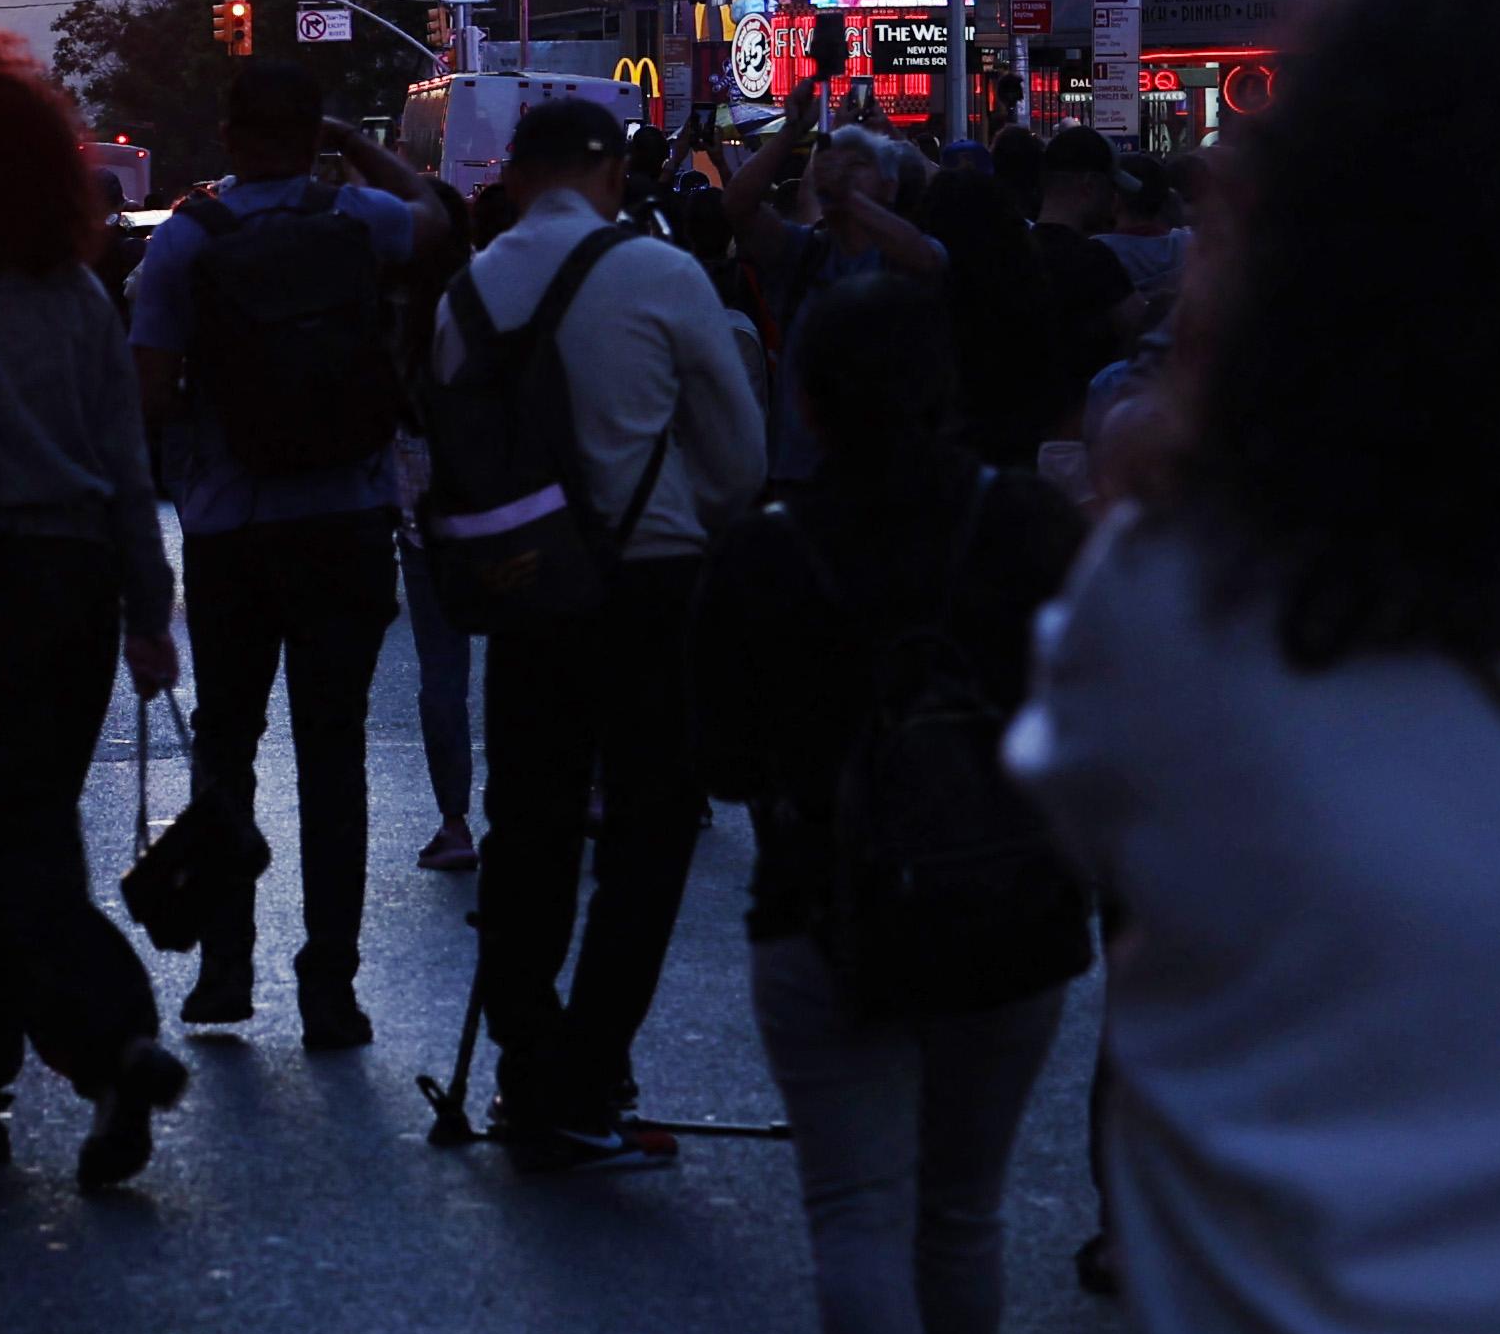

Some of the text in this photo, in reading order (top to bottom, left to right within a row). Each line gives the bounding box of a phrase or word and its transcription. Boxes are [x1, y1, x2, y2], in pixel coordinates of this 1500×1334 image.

[907, 46, 926, 54] NEW
[906, 58, 930, 66] TIMES
[1149, 92, 1184, 100] STEAKS
